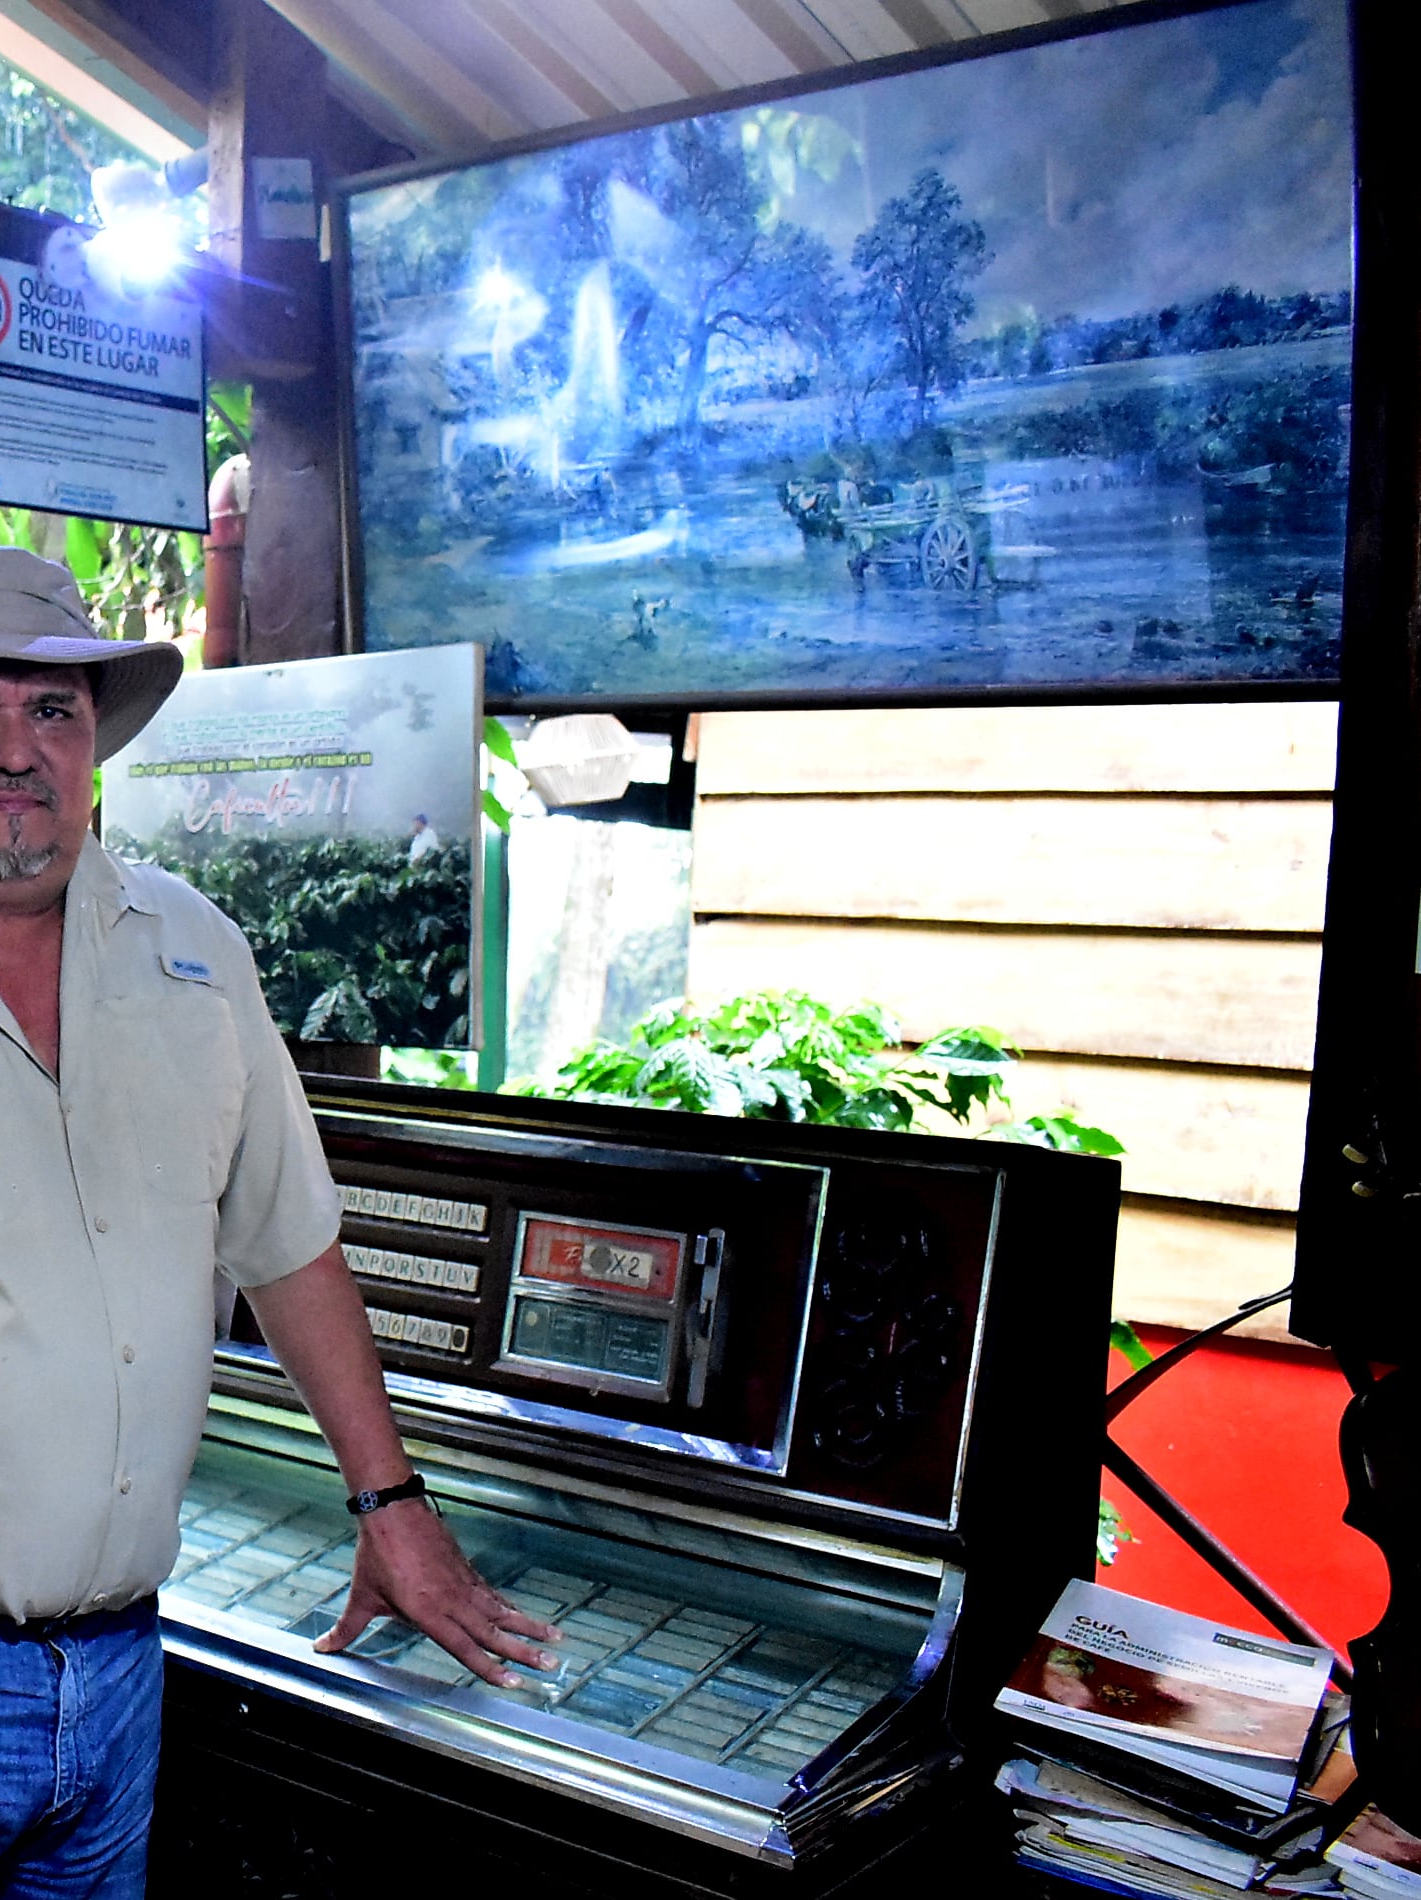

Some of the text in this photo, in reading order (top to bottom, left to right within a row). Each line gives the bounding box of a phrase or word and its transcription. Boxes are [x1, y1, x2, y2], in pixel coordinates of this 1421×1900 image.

[19, 276, 86, 312] QUEDA
[19, 303, 191, 360] PROHIBIDO FUMAR
[19, 330, 159, 378] EN ESTE LUGAR
[1075, 1615, 1129, 1640] GUÍA
